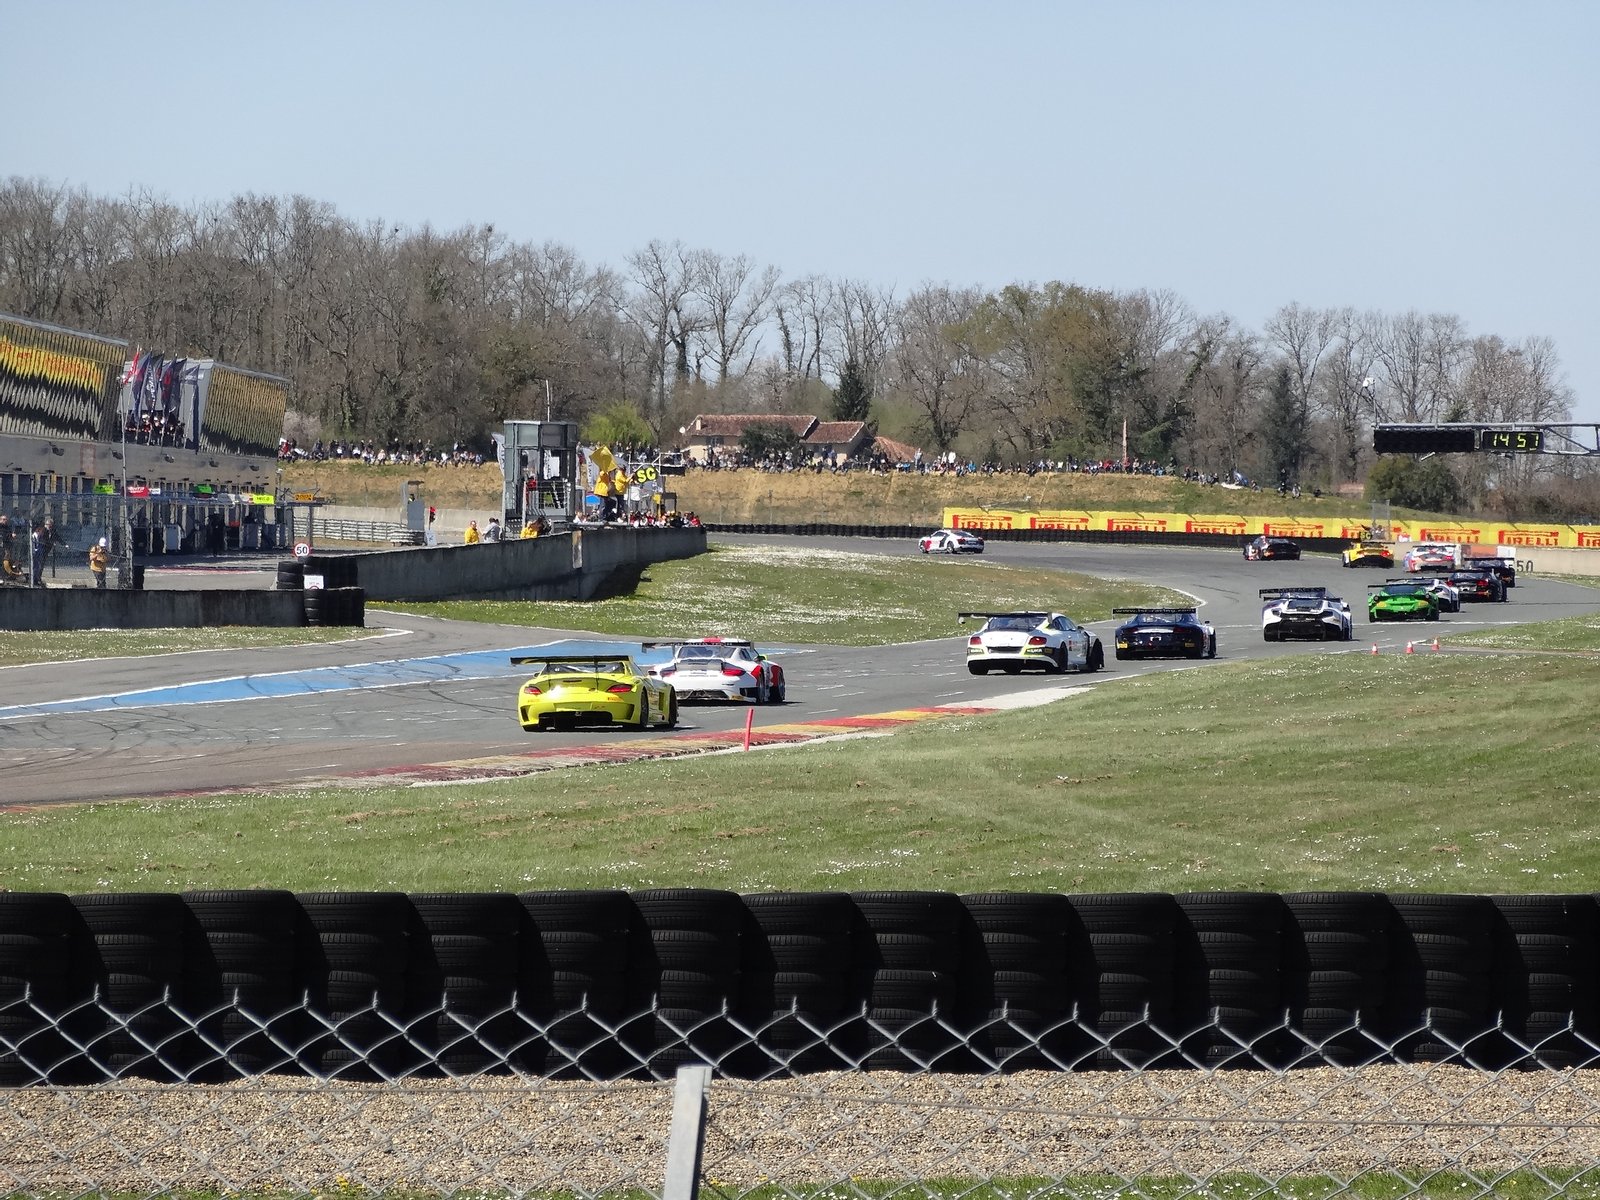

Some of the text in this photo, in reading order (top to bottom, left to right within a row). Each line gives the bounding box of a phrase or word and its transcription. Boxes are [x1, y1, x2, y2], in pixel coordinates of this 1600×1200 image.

[1493, 433, 1539, 448] 14 57
[635, 467, 657, 483] SC
[1420, 528, 1481, 544] PRELLI
[1497, 530, 1560, 547] PIRELLI
[296, 546, 308, 556] 50
[1516, 560, 1534, 573] 50
